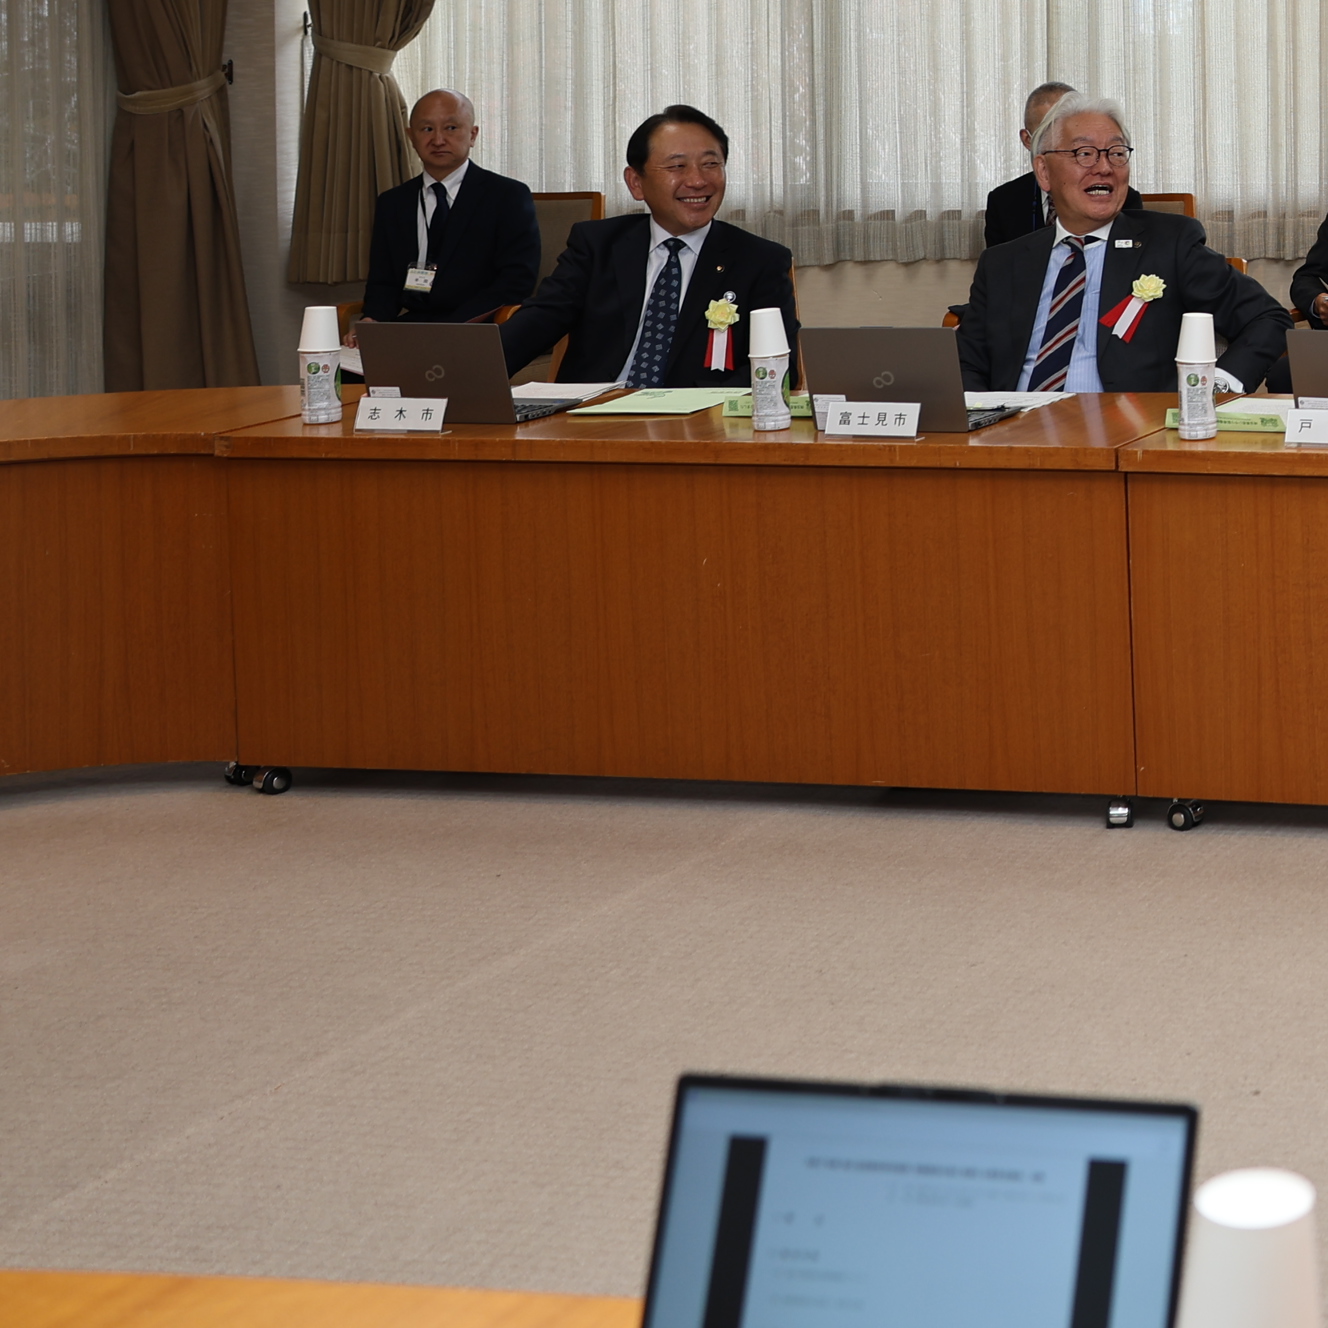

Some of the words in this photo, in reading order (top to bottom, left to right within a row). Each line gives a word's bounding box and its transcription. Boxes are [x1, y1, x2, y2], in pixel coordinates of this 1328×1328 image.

[367, 406, 434, 422] 志木市
[838, 411, 908, 427] 富士見市
